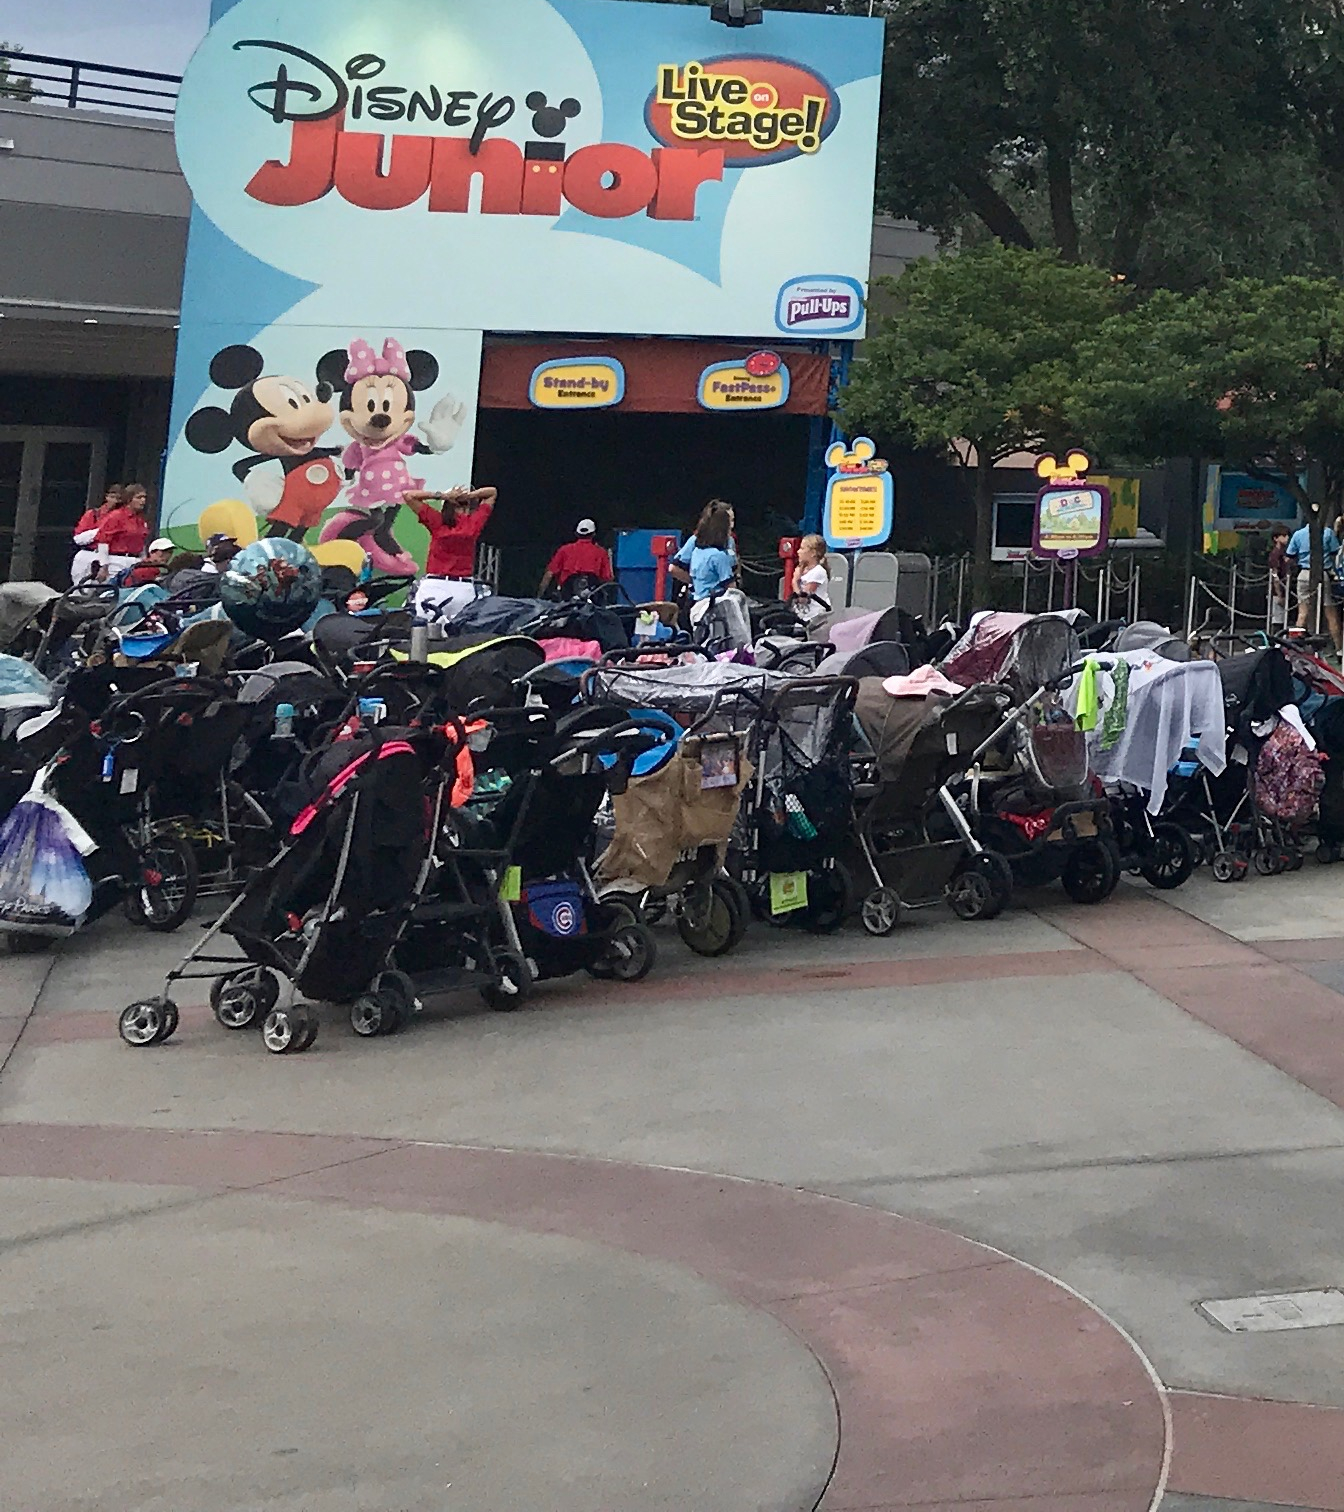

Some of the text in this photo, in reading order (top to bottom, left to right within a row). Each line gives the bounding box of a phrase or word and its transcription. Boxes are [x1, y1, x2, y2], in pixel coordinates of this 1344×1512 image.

[661, 65, 770, 104] Live on
[676, 100, 821, 148] Stage!
[244, 100, 725, 222] Junior
[790, 297, 848, 322] Pull-Ups
[543, 377, 609, 392] Stand-by
[557, 390, 596, 398] Entrance
[725, 394, 762, 402] Entrance
